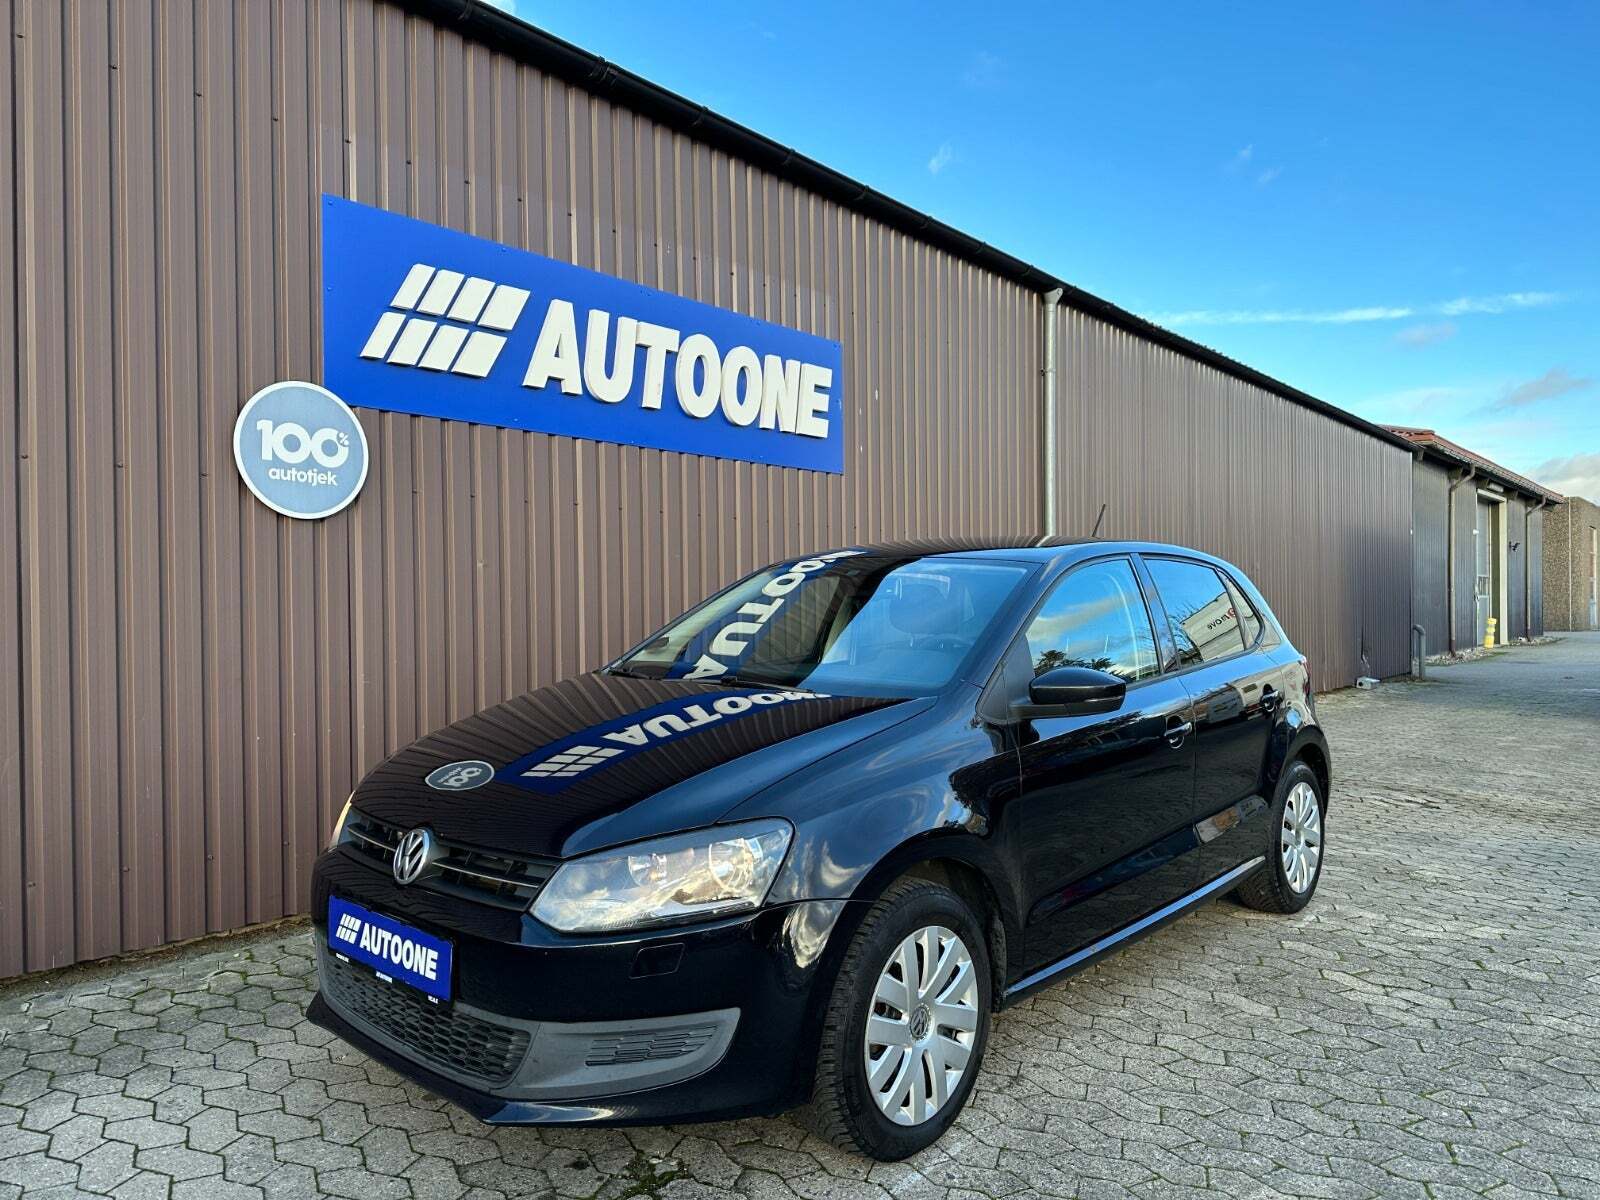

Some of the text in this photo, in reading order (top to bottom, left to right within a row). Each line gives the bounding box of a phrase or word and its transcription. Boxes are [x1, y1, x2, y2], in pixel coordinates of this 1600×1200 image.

[522, 298, 833, 439] AUTOONE
[268, 467, 338, 487] autotjek
[359, 922, 439, 981] AUTOONE
